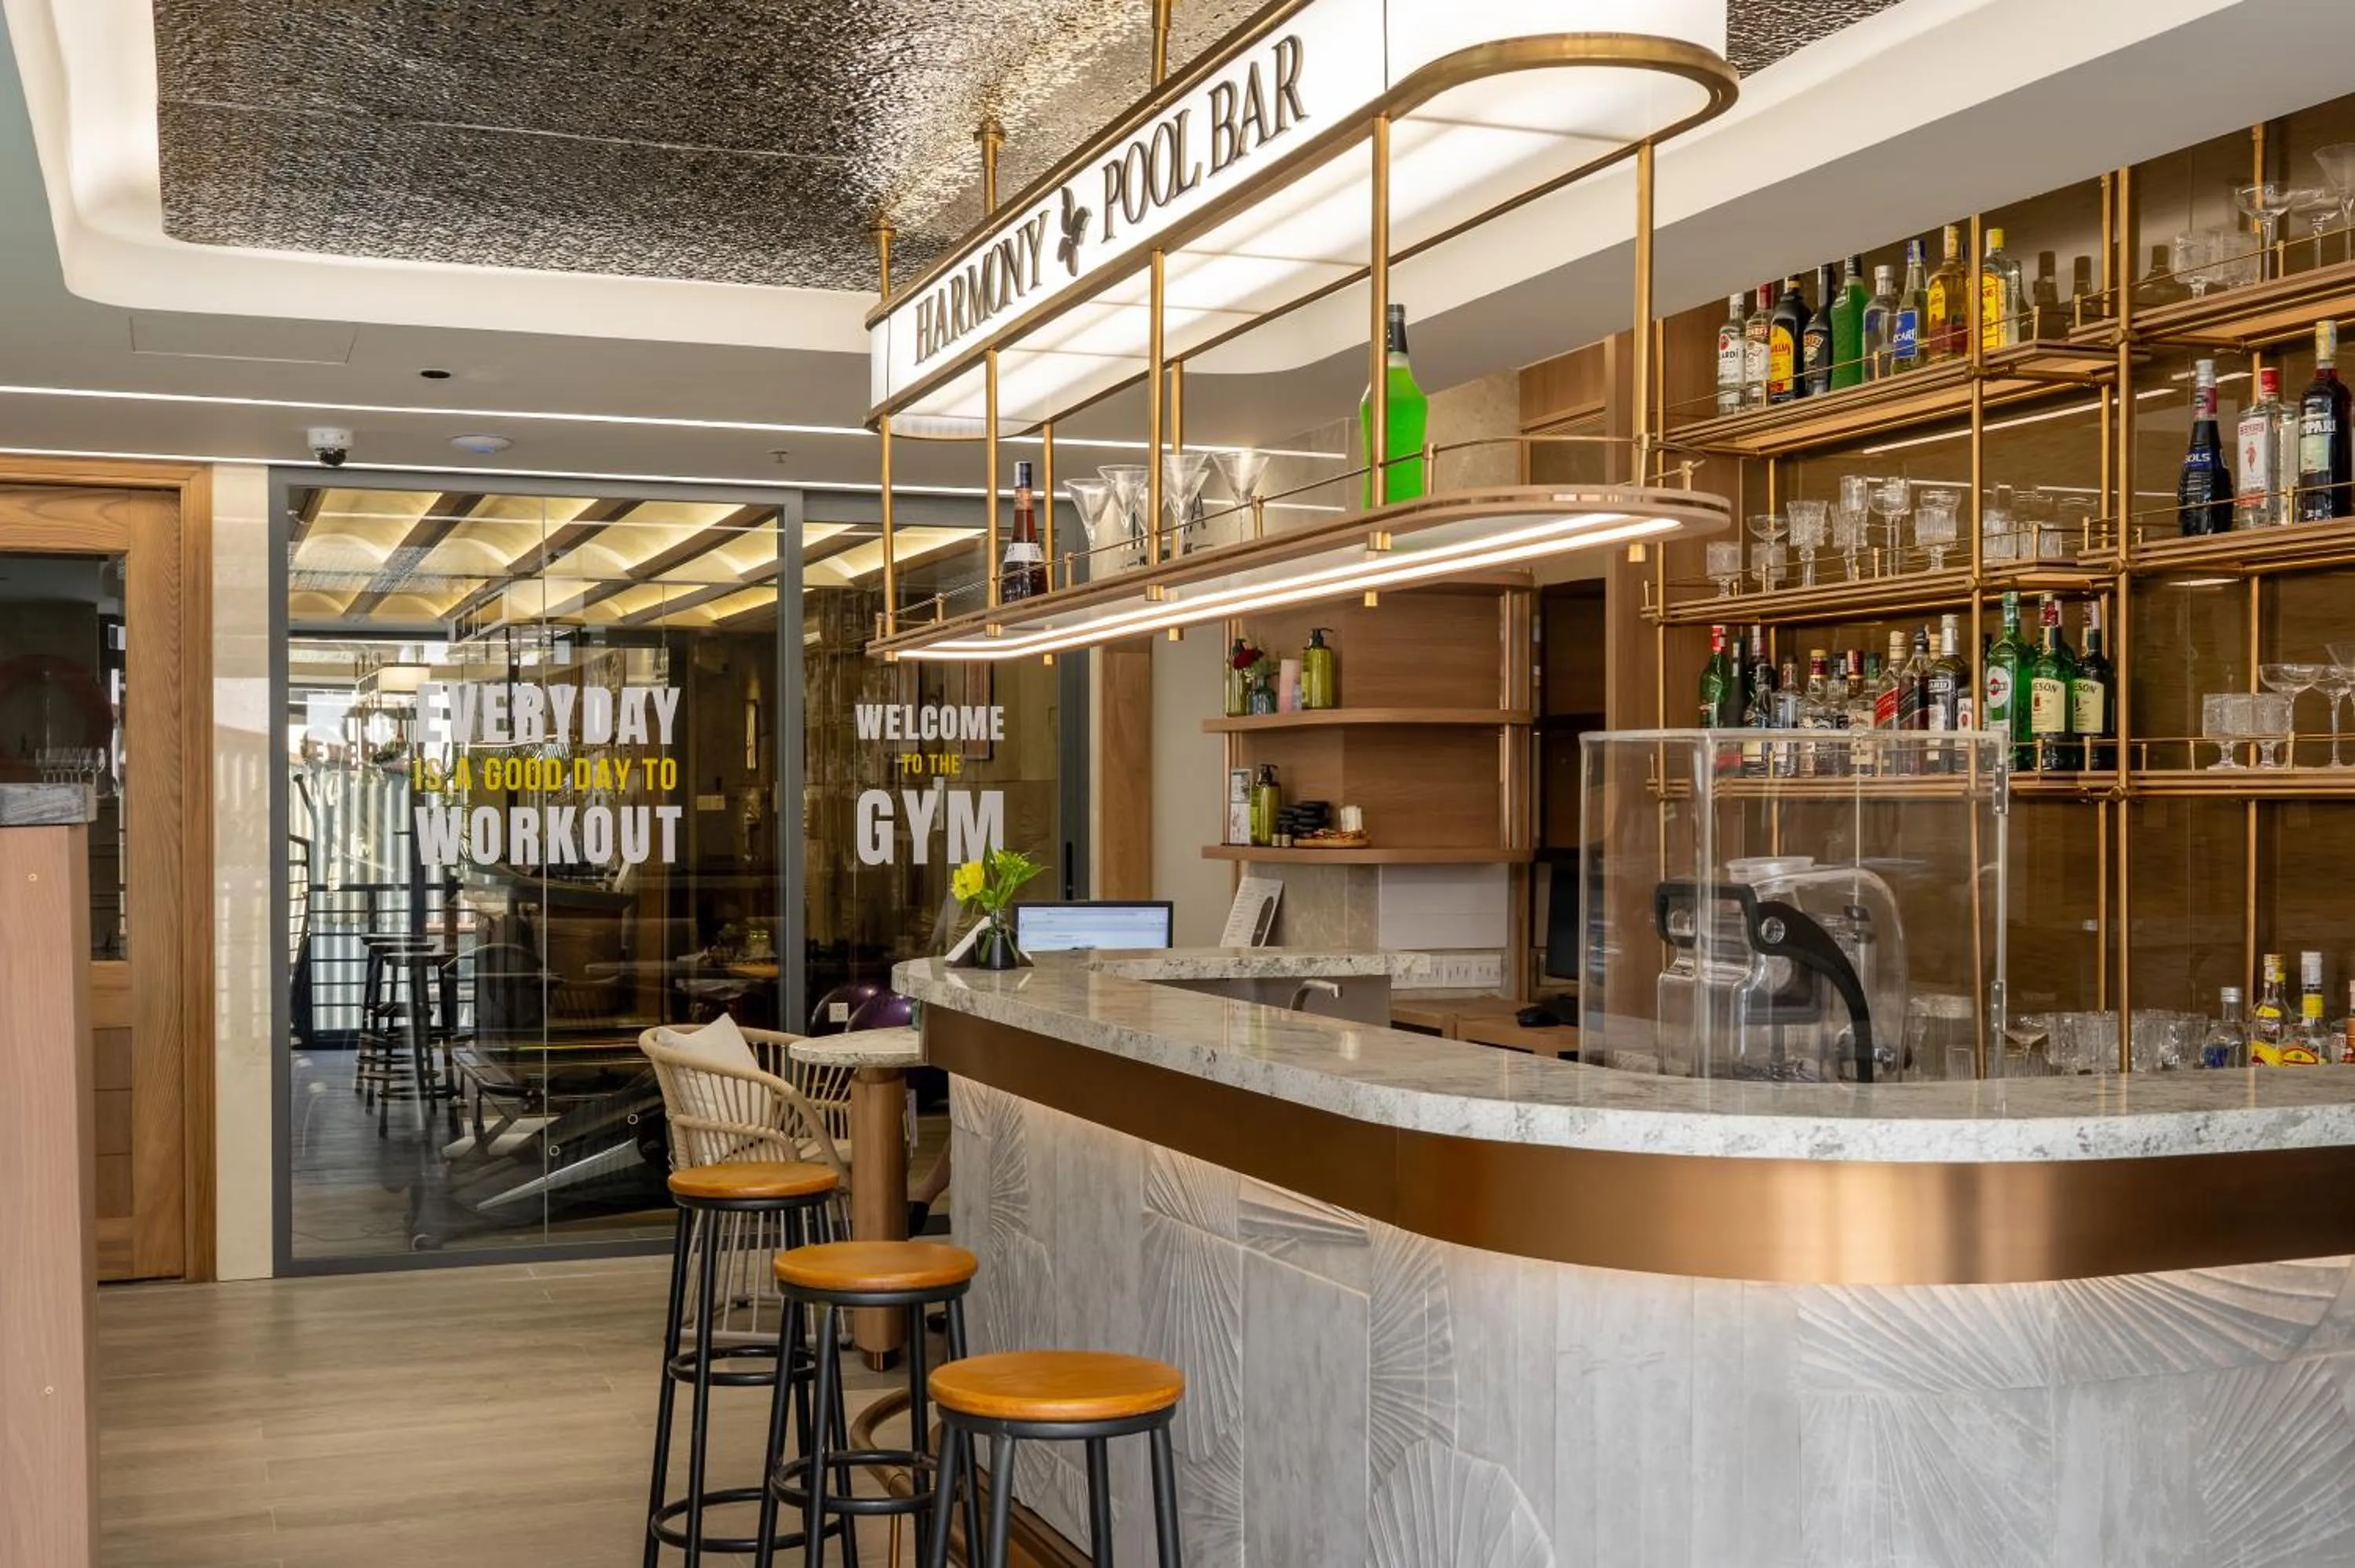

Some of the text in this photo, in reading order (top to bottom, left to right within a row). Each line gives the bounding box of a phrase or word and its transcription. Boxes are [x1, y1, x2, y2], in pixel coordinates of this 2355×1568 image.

[914, 34, 1311, 366] HARMONY POOL BAR
[2032, 682, 2058, 694] ESON
[417, 682, 681, 745] EVERYDAY
[855, 704, 1004, 740] WELCOME
[413, 757, 677, 792] IS A GOOD DAY TO
[903, 753, 961, 775] TO THE
[415, 805, 682, 866] WORKOUT
[856, 789, 1005, 865] GYM
